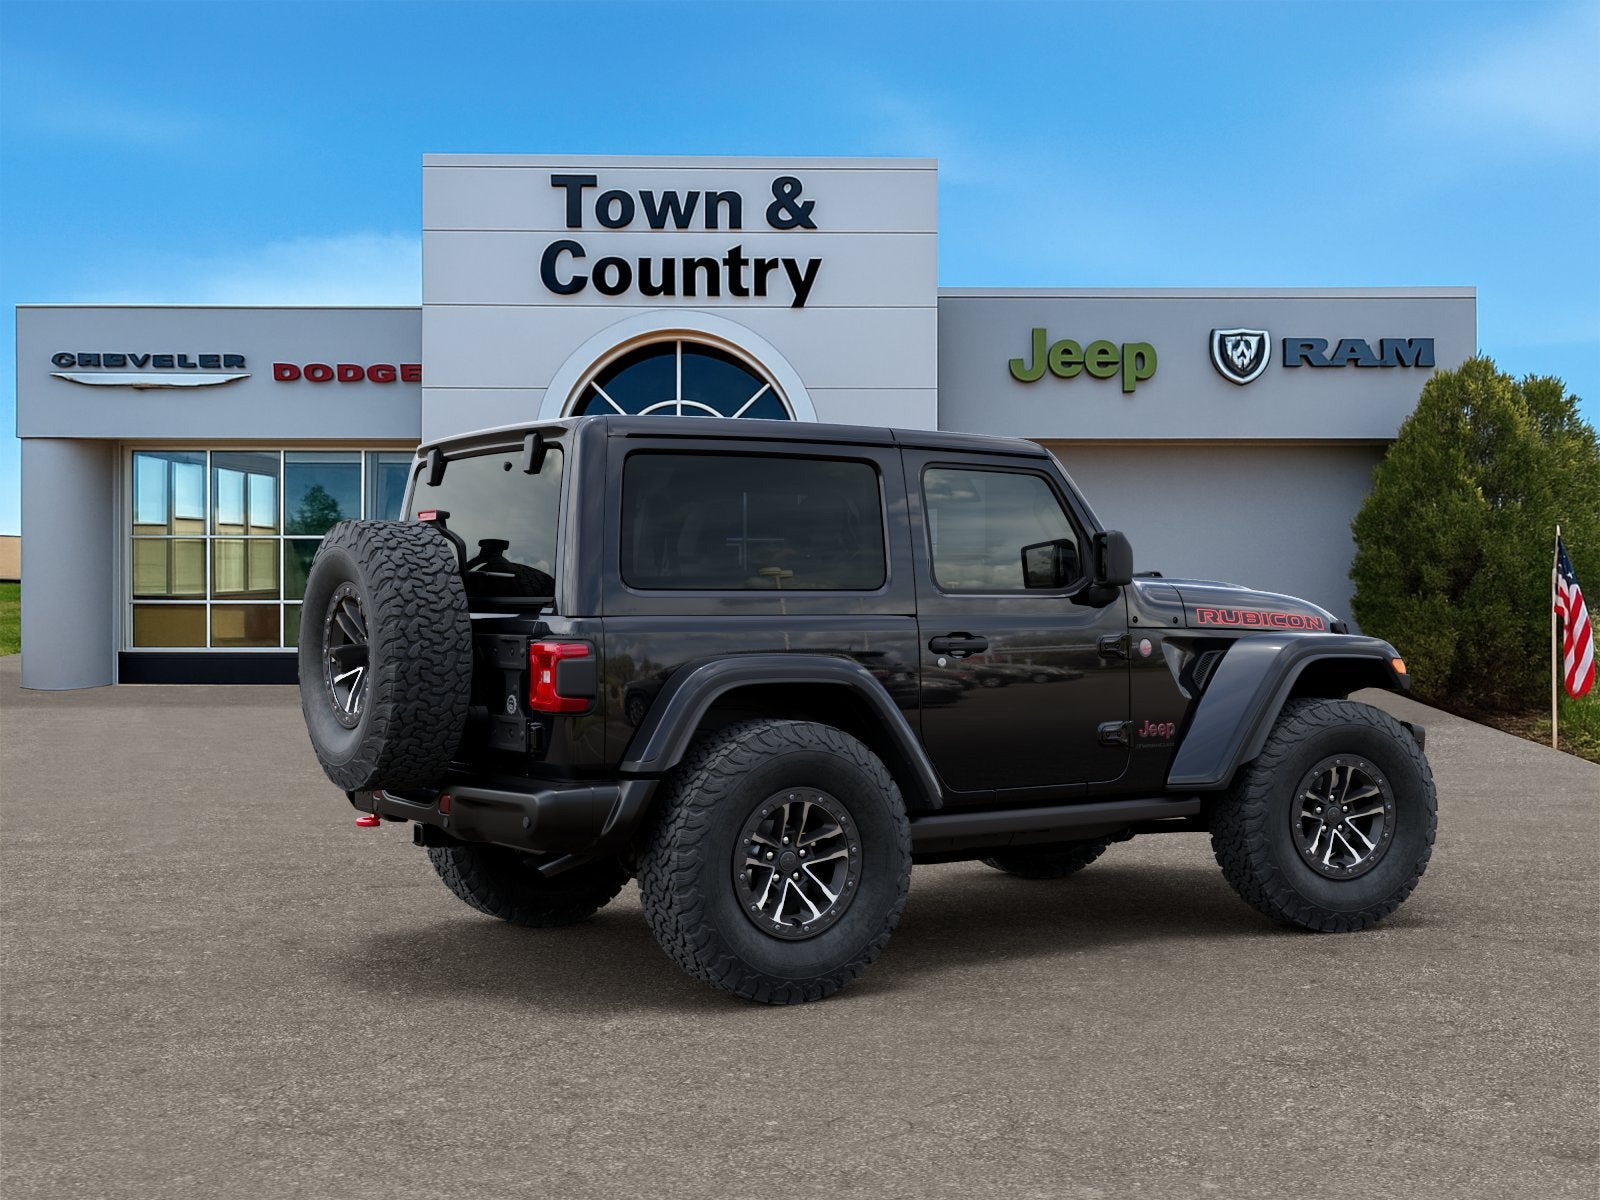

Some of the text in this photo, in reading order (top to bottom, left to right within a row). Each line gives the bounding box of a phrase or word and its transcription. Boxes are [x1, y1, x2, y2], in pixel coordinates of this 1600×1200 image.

[550, 174, 818, 230] Town &
[539, 239, 822, 308] Country
[1008, 328, 1158, 393] Jeep
[1282, 337, 1436, 368] RAM
[273, 363, 422, 383] DODGE
[1196, 608, 1325, 631] RUBICON
[1137, 720, 1176, 740] Jeep
